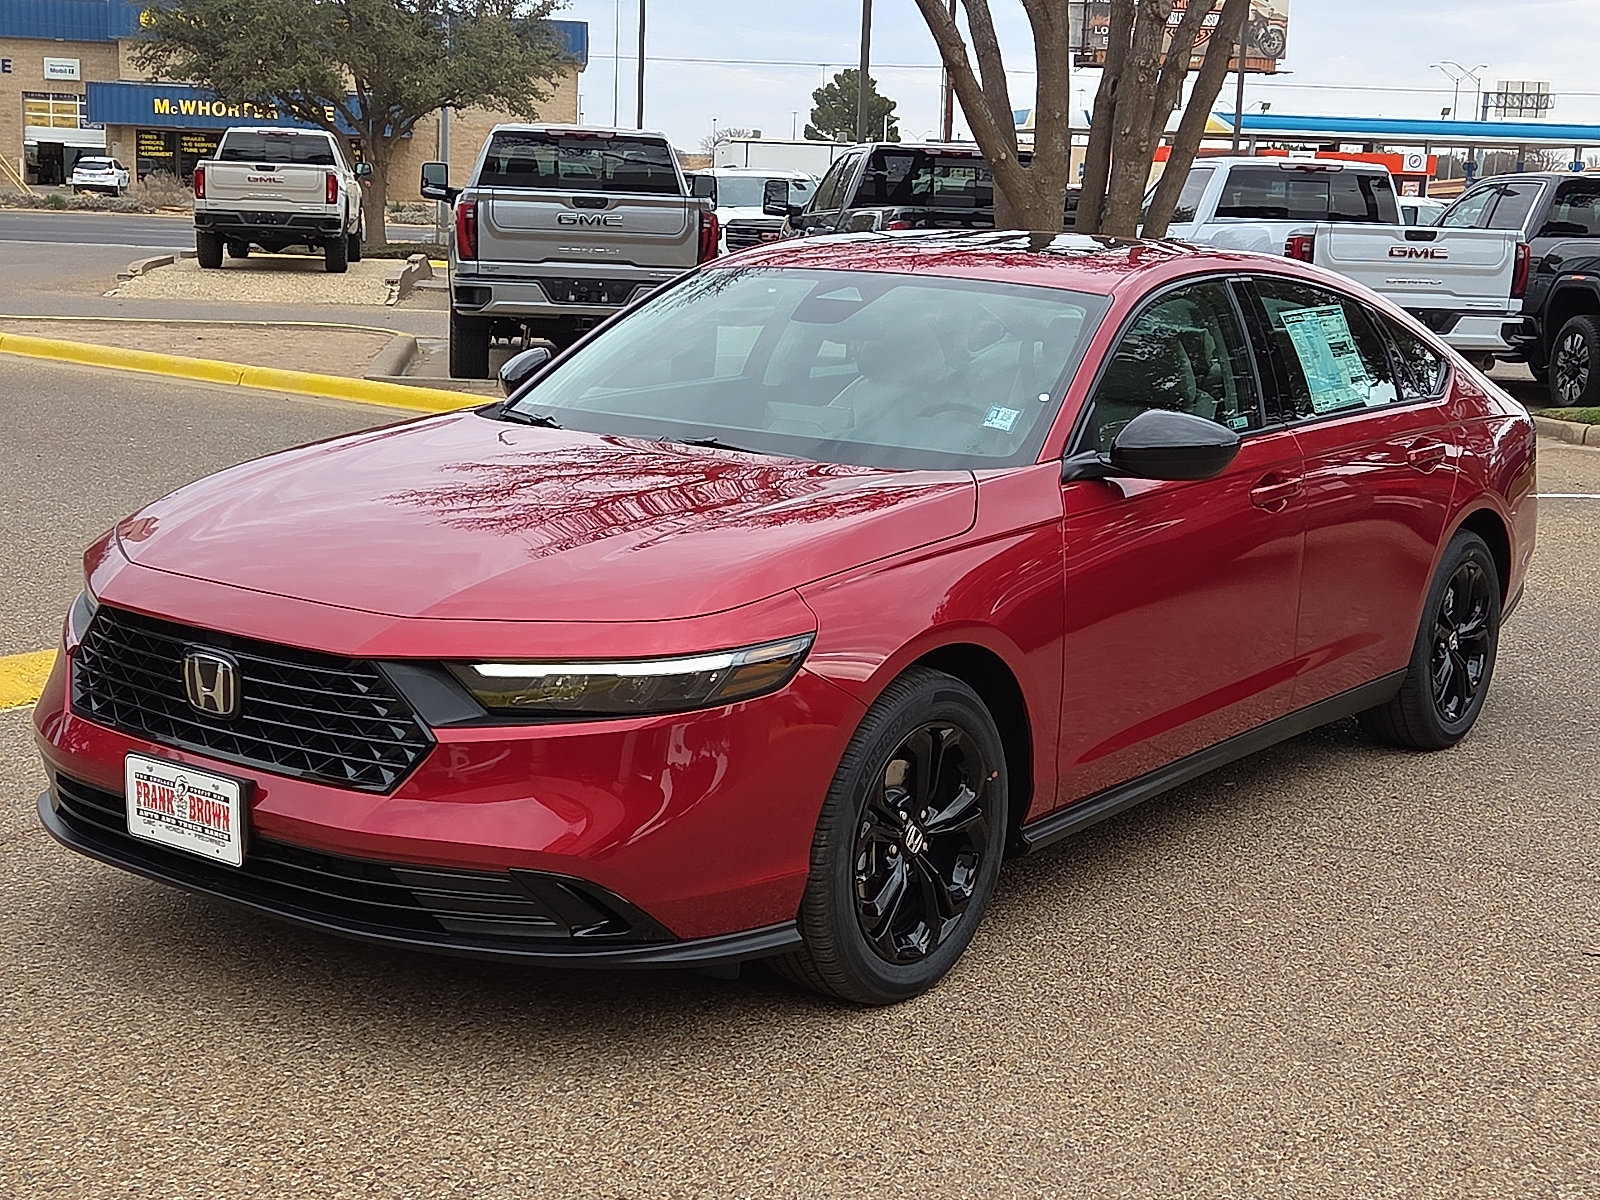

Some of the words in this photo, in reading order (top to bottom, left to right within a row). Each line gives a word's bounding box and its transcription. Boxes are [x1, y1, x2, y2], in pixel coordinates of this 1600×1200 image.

[246, 175, 285, 184] GMC
[556, 212, 623, 227] GMC
[1388, 245, 1449, 260] GMC
[136, 780, 175, 816] FRANK
[188, 794, 231, 833] BROWN
[138, 808, 160, 820] AUTO
[162, 815, 177, 826] AND
[178, 819, 203, 834] TRUCK
[205, 827, 229, 841] RANCH
